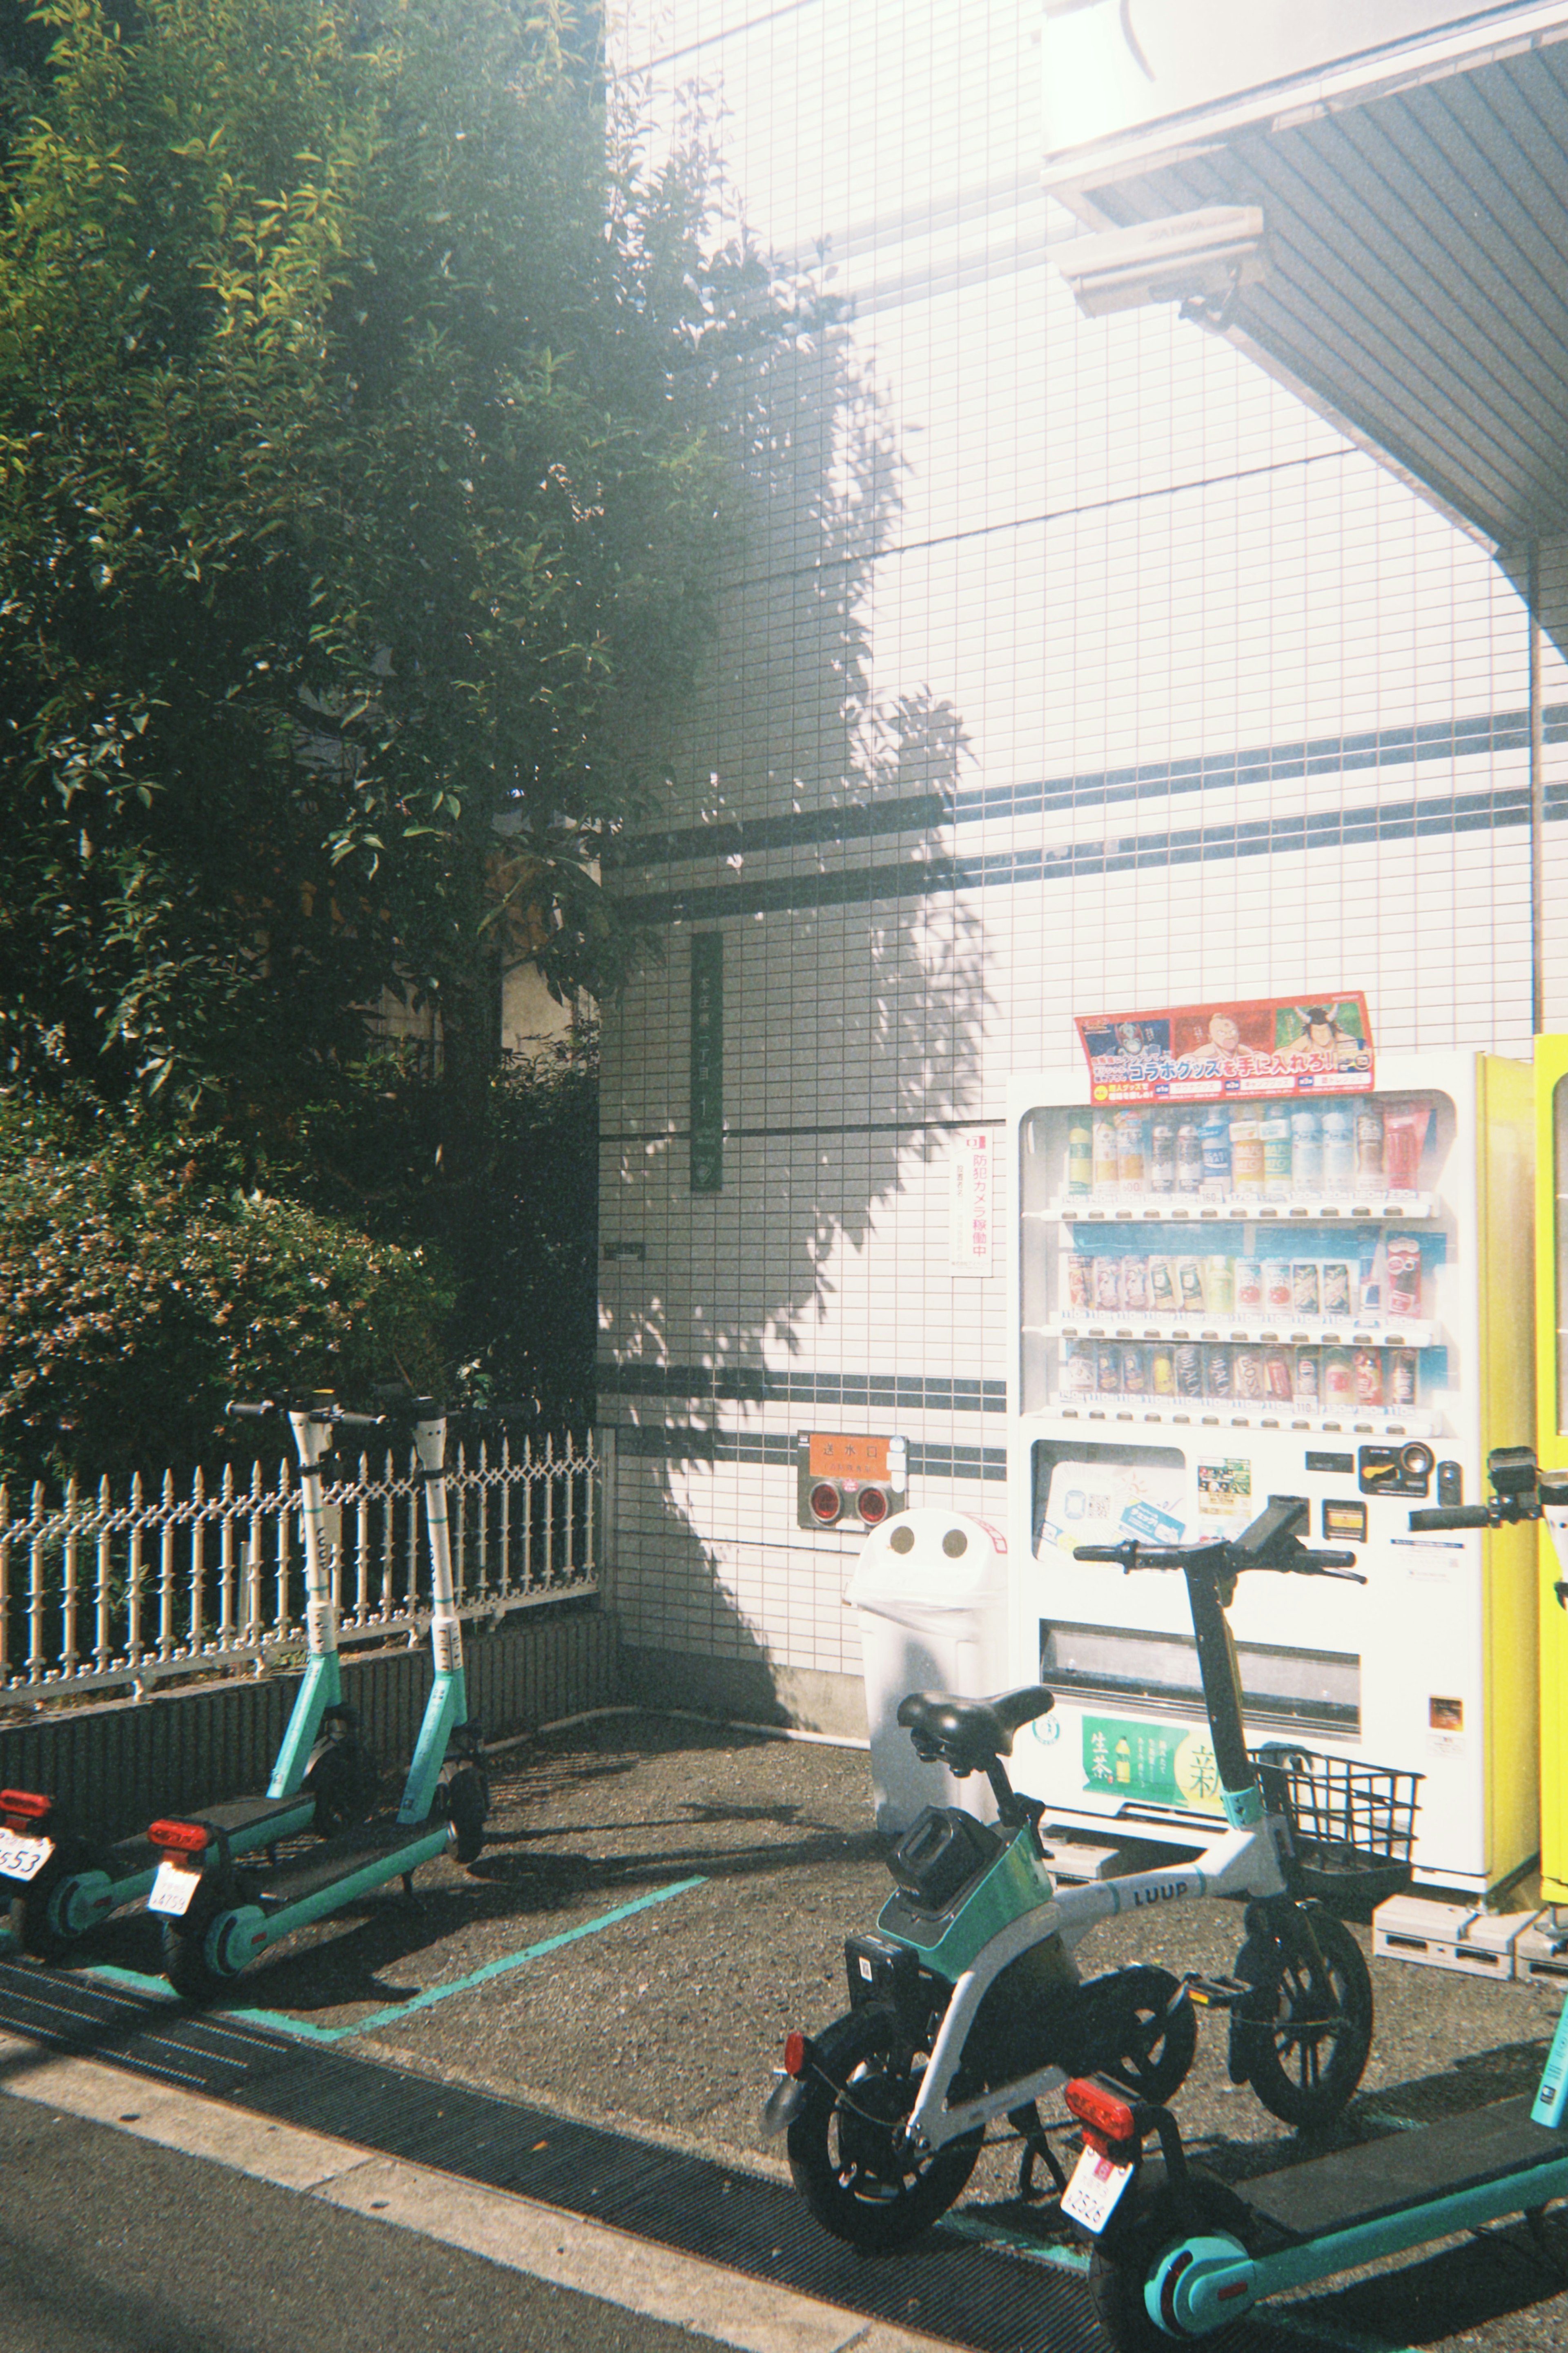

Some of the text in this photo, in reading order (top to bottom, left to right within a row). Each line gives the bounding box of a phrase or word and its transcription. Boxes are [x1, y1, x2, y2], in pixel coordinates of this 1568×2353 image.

[972, 1154, 987, 1257] 防犯カメラ稼働中
[1241, 1358, 1261, 1396] BOSS
[823, 1443, 878, 1458] 送水口
[1091, 1731, 1114, 1780] 生茶
[0, 1850, 41, 1873] 553
[1133, 1880, 1188, 1907] LUUP
[1071, 2190, 1105, 2224] 2526
